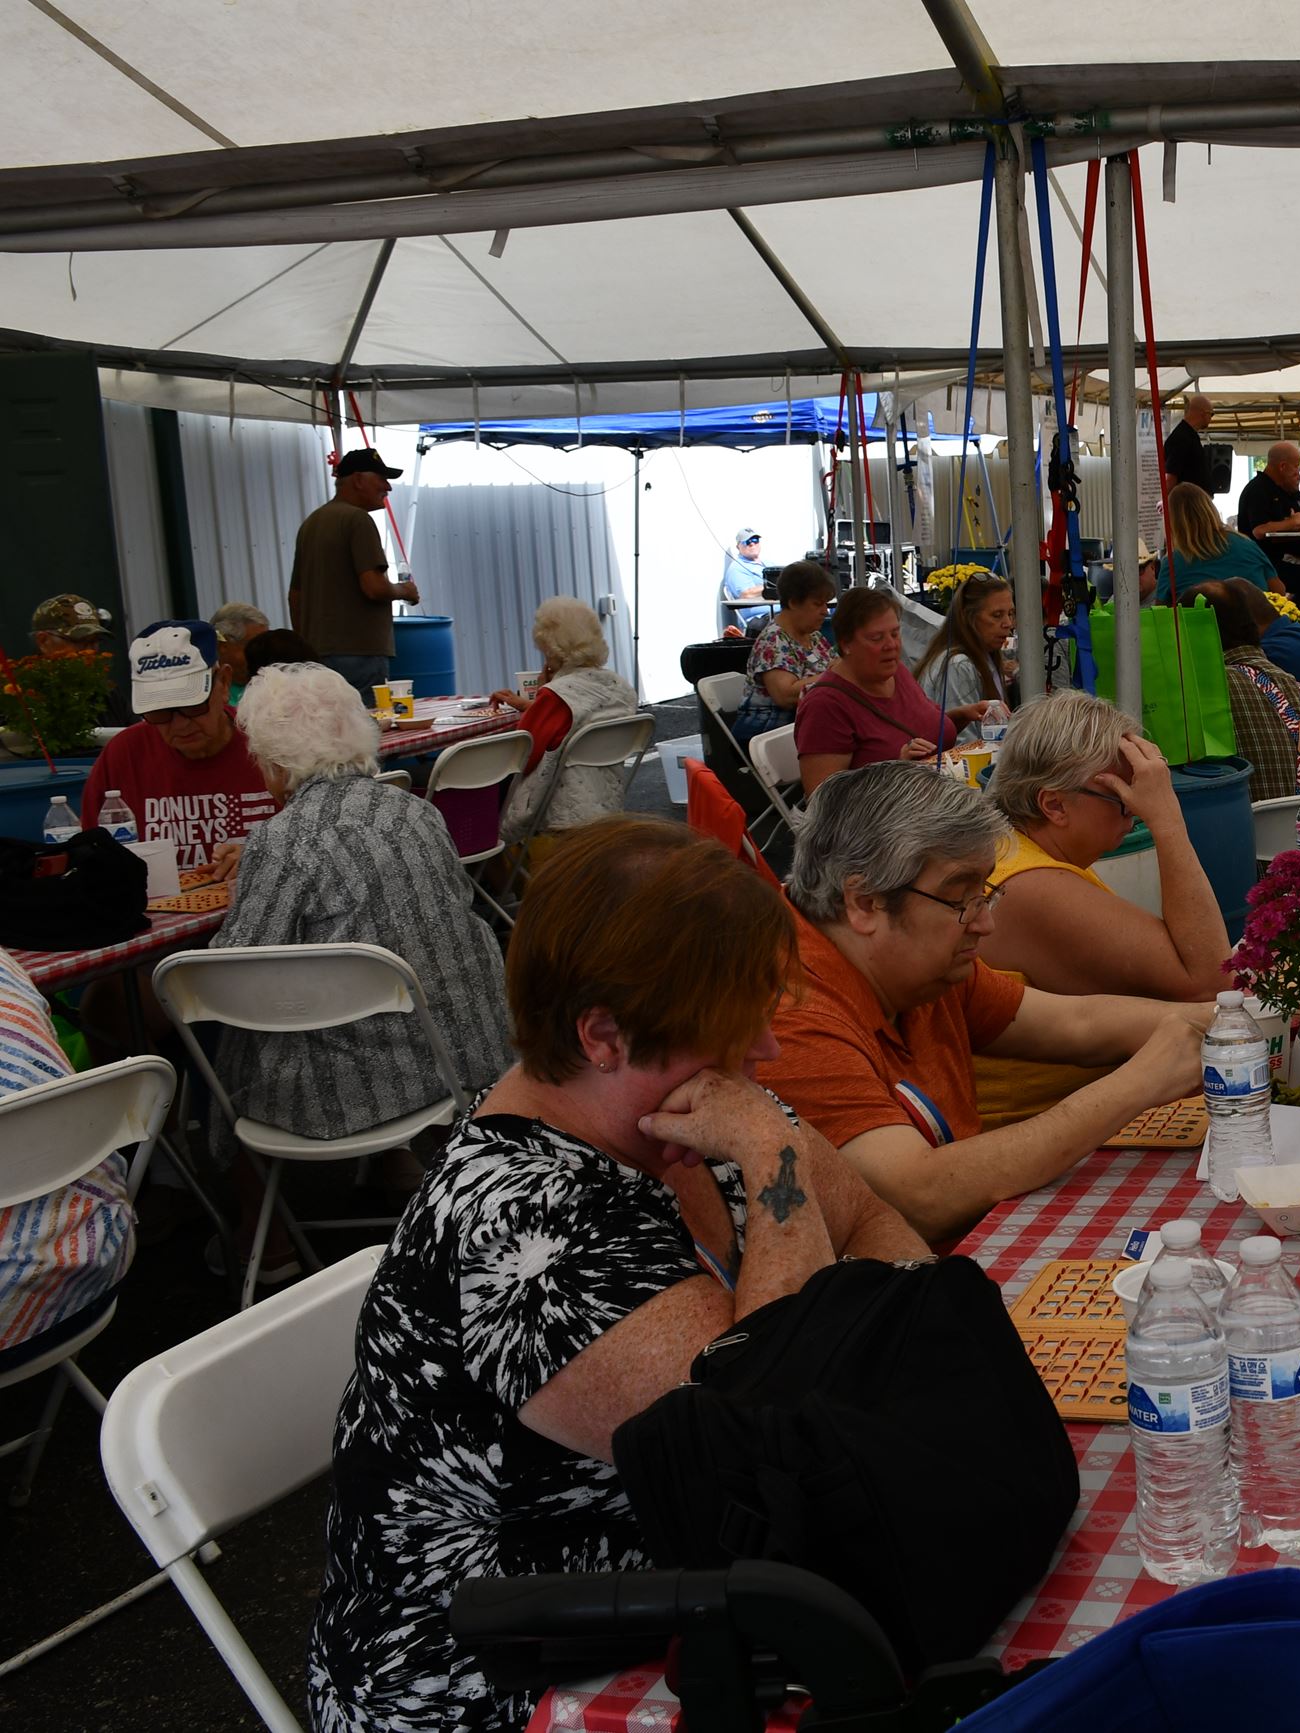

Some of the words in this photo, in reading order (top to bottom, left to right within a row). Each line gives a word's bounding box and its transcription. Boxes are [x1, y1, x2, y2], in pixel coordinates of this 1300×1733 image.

[137, 655, 190, 674] Titleist
[144, 792, 229, 823] DONUTS
[144, 818, 229, 845] CONEYS
